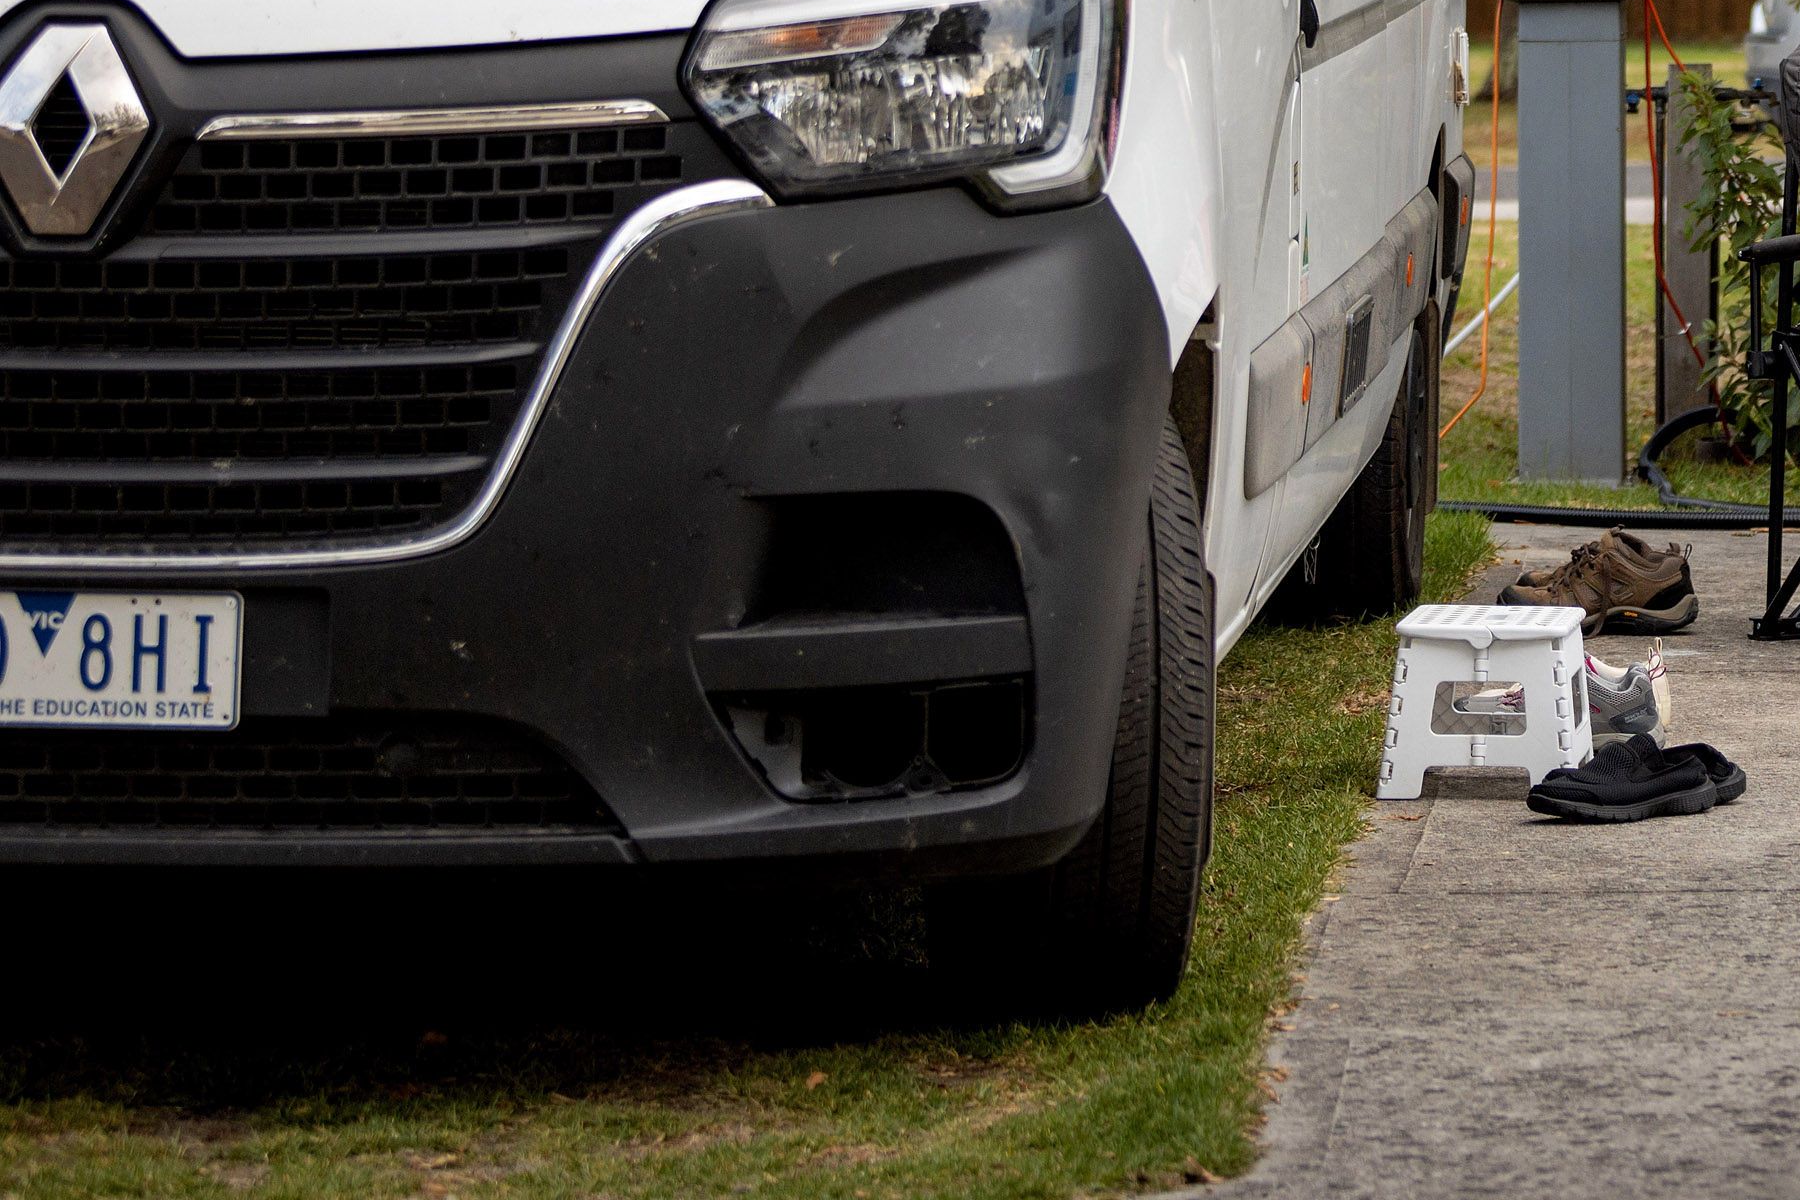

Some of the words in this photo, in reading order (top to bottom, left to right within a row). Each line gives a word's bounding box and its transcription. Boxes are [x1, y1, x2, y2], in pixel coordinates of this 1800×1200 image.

[29, 611, 64, 630] VIC
[80, 613, 214, 693] 8HI
[0, 698, 26, 715] HE
[33, 699, 147, 718] EDUCATION
[155, 700, 214, 718] STATE
